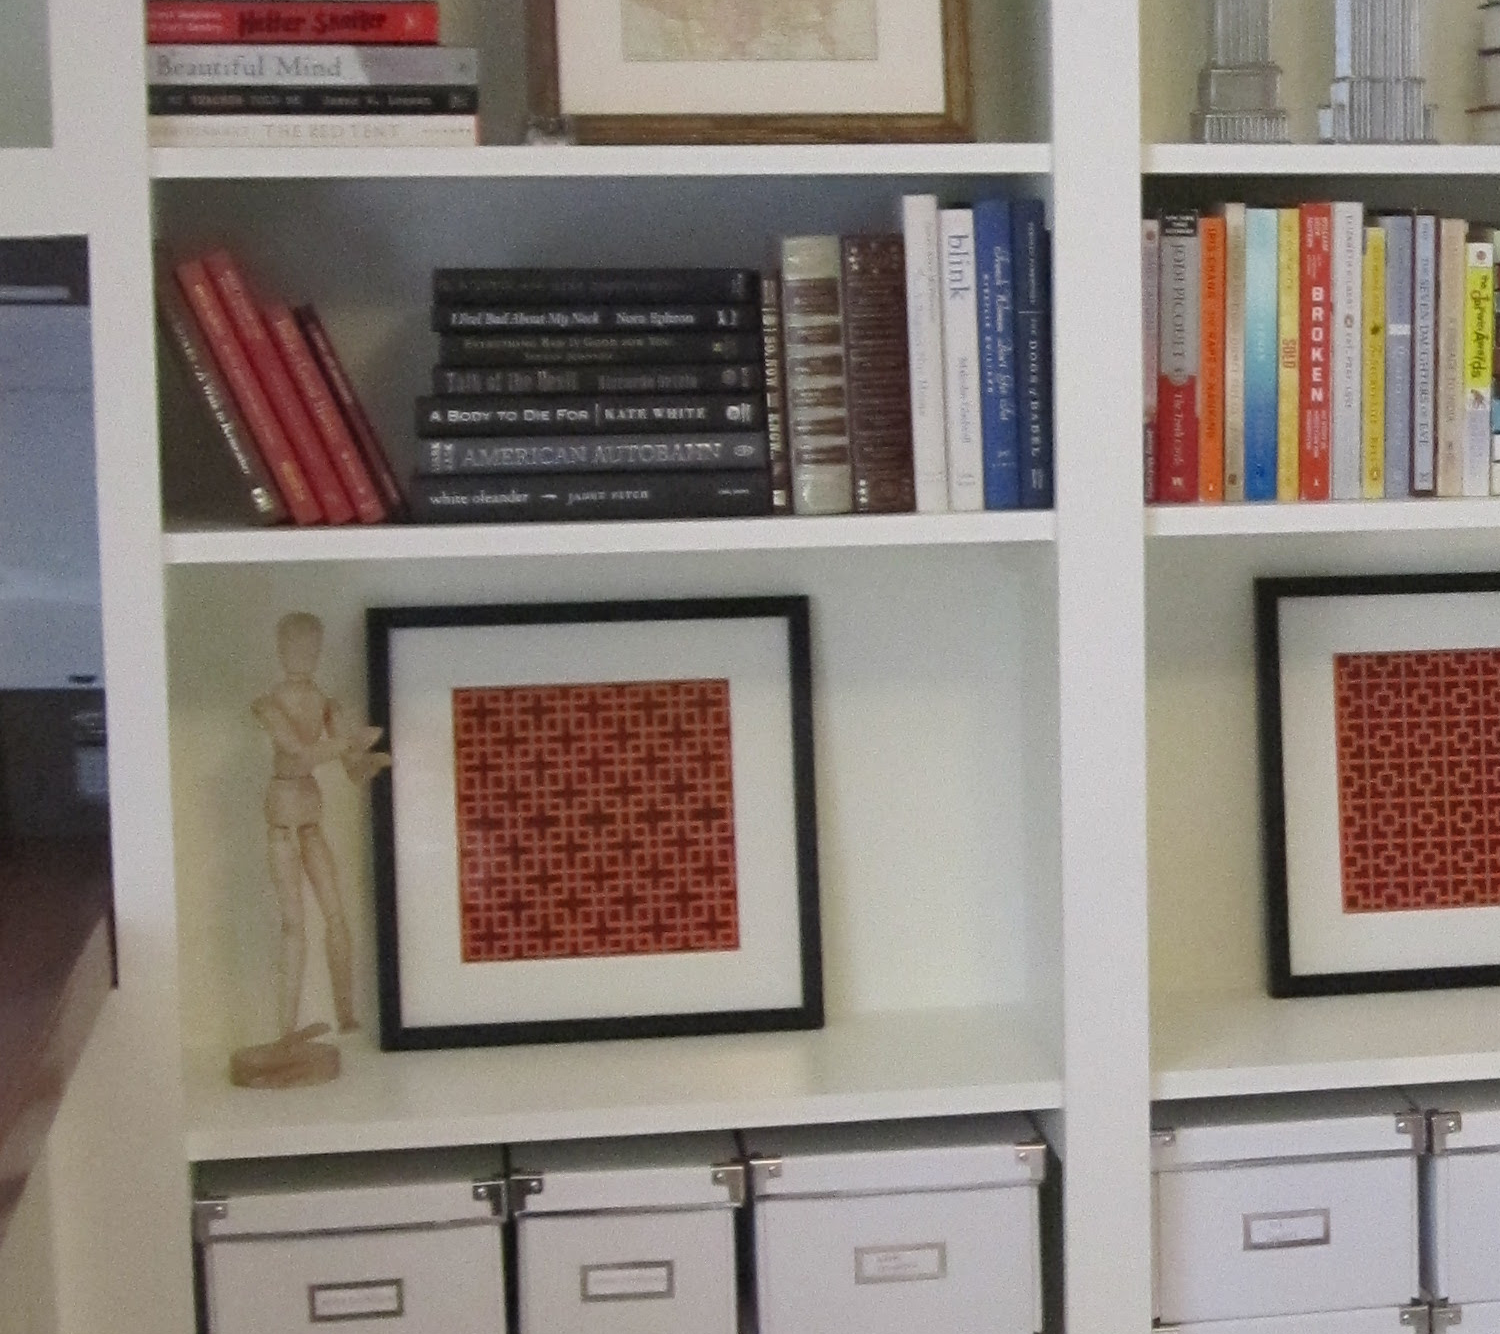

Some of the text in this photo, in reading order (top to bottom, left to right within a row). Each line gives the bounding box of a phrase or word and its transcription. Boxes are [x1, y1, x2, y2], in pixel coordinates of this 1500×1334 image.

[155, 54, 342, 78] Beautiful Mind
[948, 233, 971, 301] blink
[1282, 338, 1298, 370] SOLD
[1310, 286, 1325, 403] BROKEN
[429, 410, 443, 422] A
[556, 408, 589, 422] FOR
[461, 446, 589, 468] AMERICAN
[429, 490, 468, 506] white
